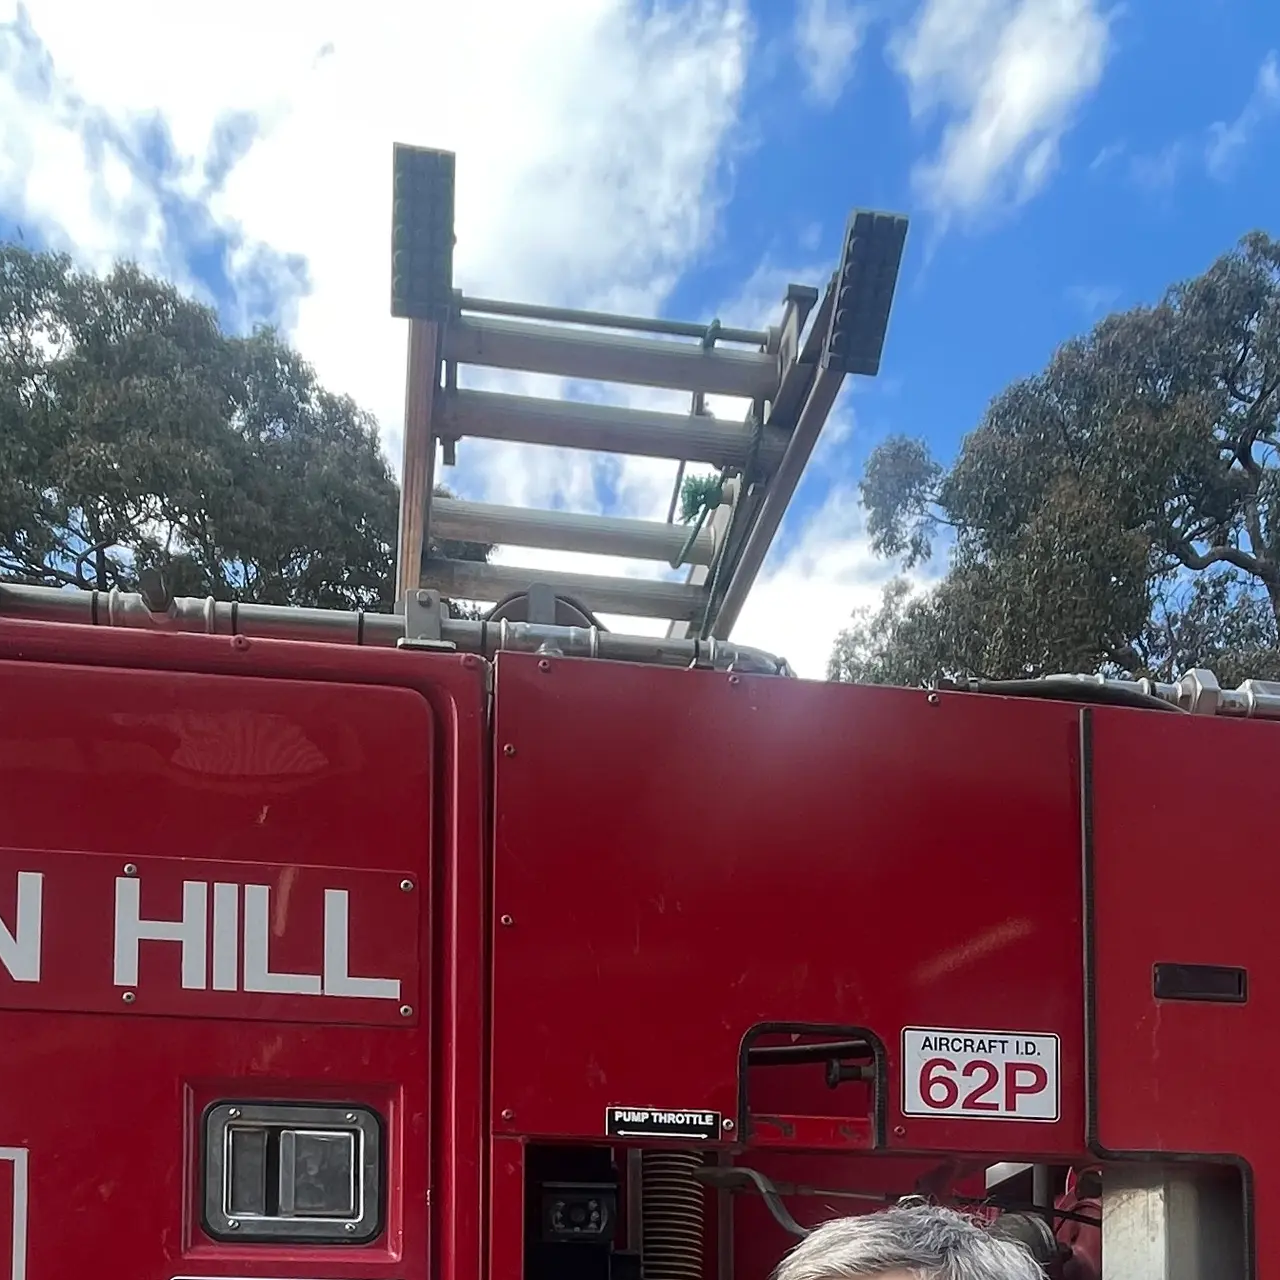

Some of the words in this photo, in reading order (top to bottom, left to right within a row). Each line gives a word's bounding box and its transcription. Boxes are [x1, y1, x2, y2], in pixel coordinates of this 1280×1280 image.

[113, 877, 401, 1000] HILL
[921, 1036, 1009, 1054] AIRCRAFT
[1015, 1040, 1041, 1056] I.D.
[919, 1057, 1048, 1112] 62P
[614, 1111, 649, 1123] PUMP
[650, 1112, 714, 1125] THROTTLE
